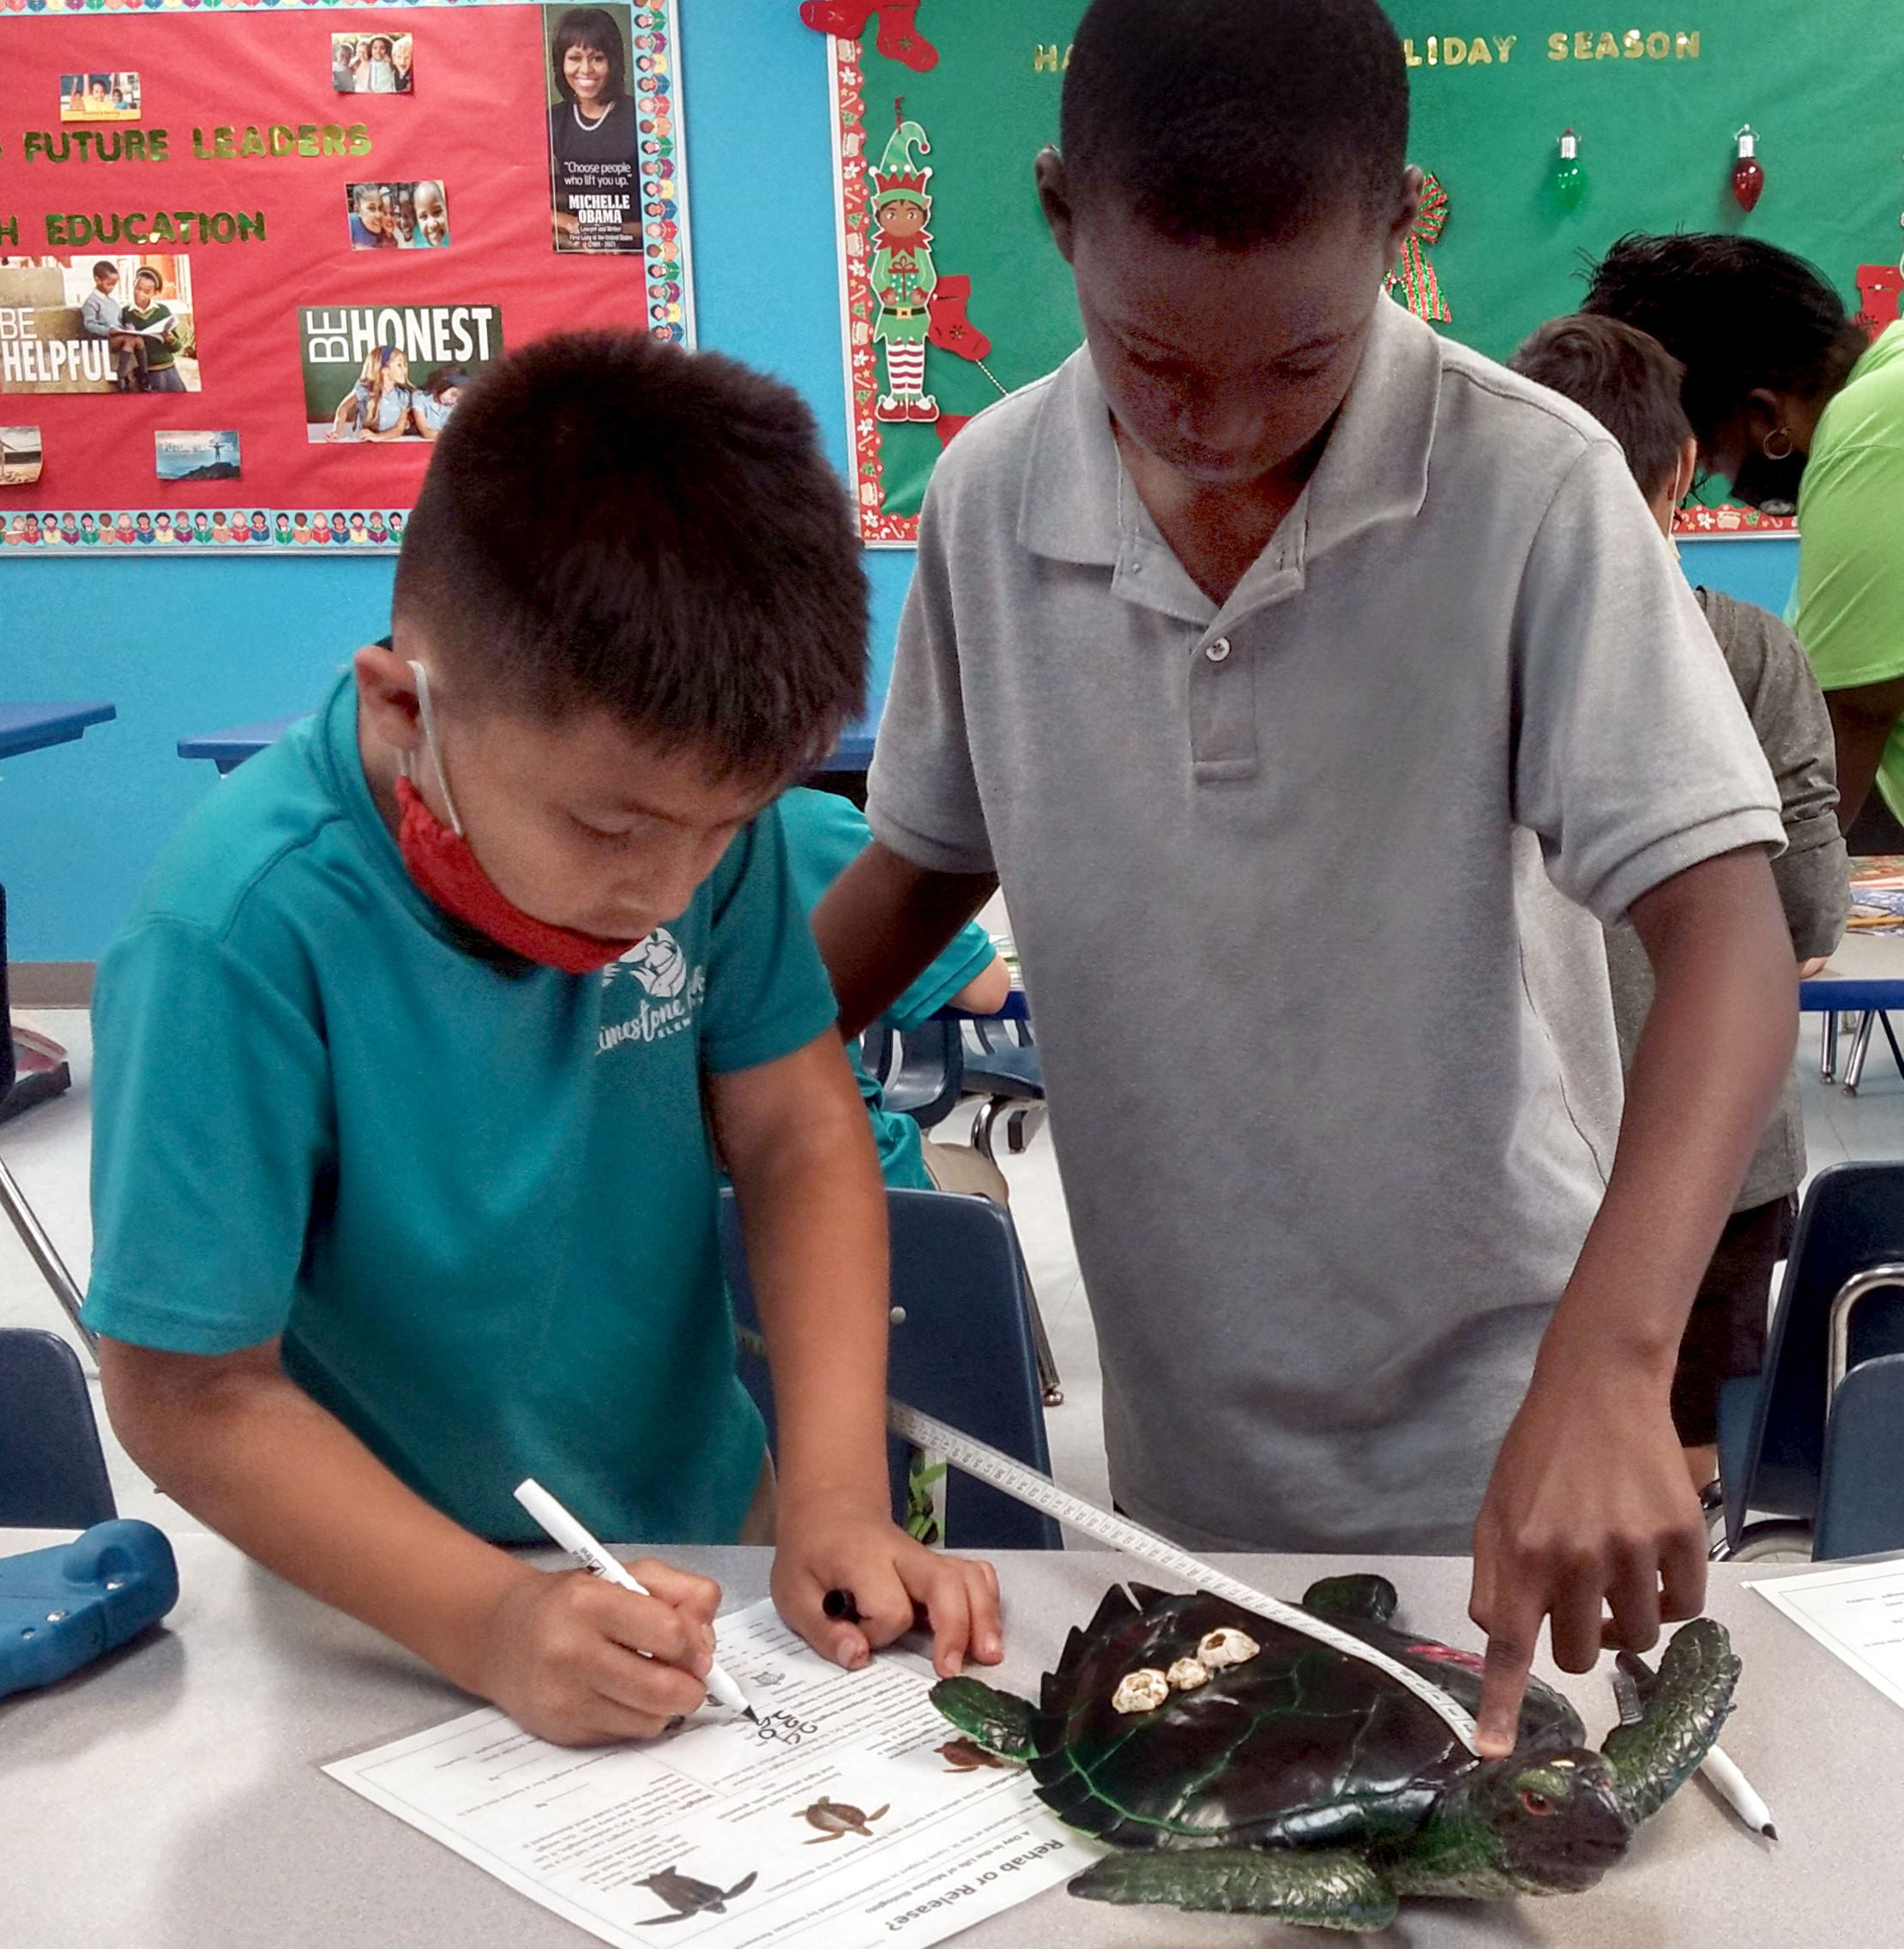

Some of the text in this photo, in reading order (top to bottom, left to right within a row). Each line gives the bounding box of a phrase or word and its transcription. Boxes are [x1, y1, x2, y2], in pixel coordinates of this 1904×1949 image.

[1403, 35, 1517, 68] LIDAY
[1547, 29, 1700, 61] SEASON
[24, 123, 372, 164] FUTURE LEADERS
[600, 161, 630, 175] people
[563, 174, 583, 185] who
[584, 174, 596, 185] lift
[597, 176, 614, 188] you
[568, 194, 630, 209] MICHELLE
[45, 211, 267, 245] EDUCATION
[578, 209, 623, 224] OBAMA
[0, 308, 37, 340] BE
[307, 308, 493, 364] BE HONEST
[3, 340, 118, 382] HELPFUL
[595, 999, 685, 1056] imestone
[757, 1716, 806, 1740] 20
[1002, 1834, 1022, 1844] Day
[957, 1857, 977, 1868] Life
[974, 1849, 993, 1858] the
[884, 1838, 1064, 1931] Rehab or Release?
[911, 1873, 948, 1891] Marine
[865, 1890, 912, 1913] Biologists
